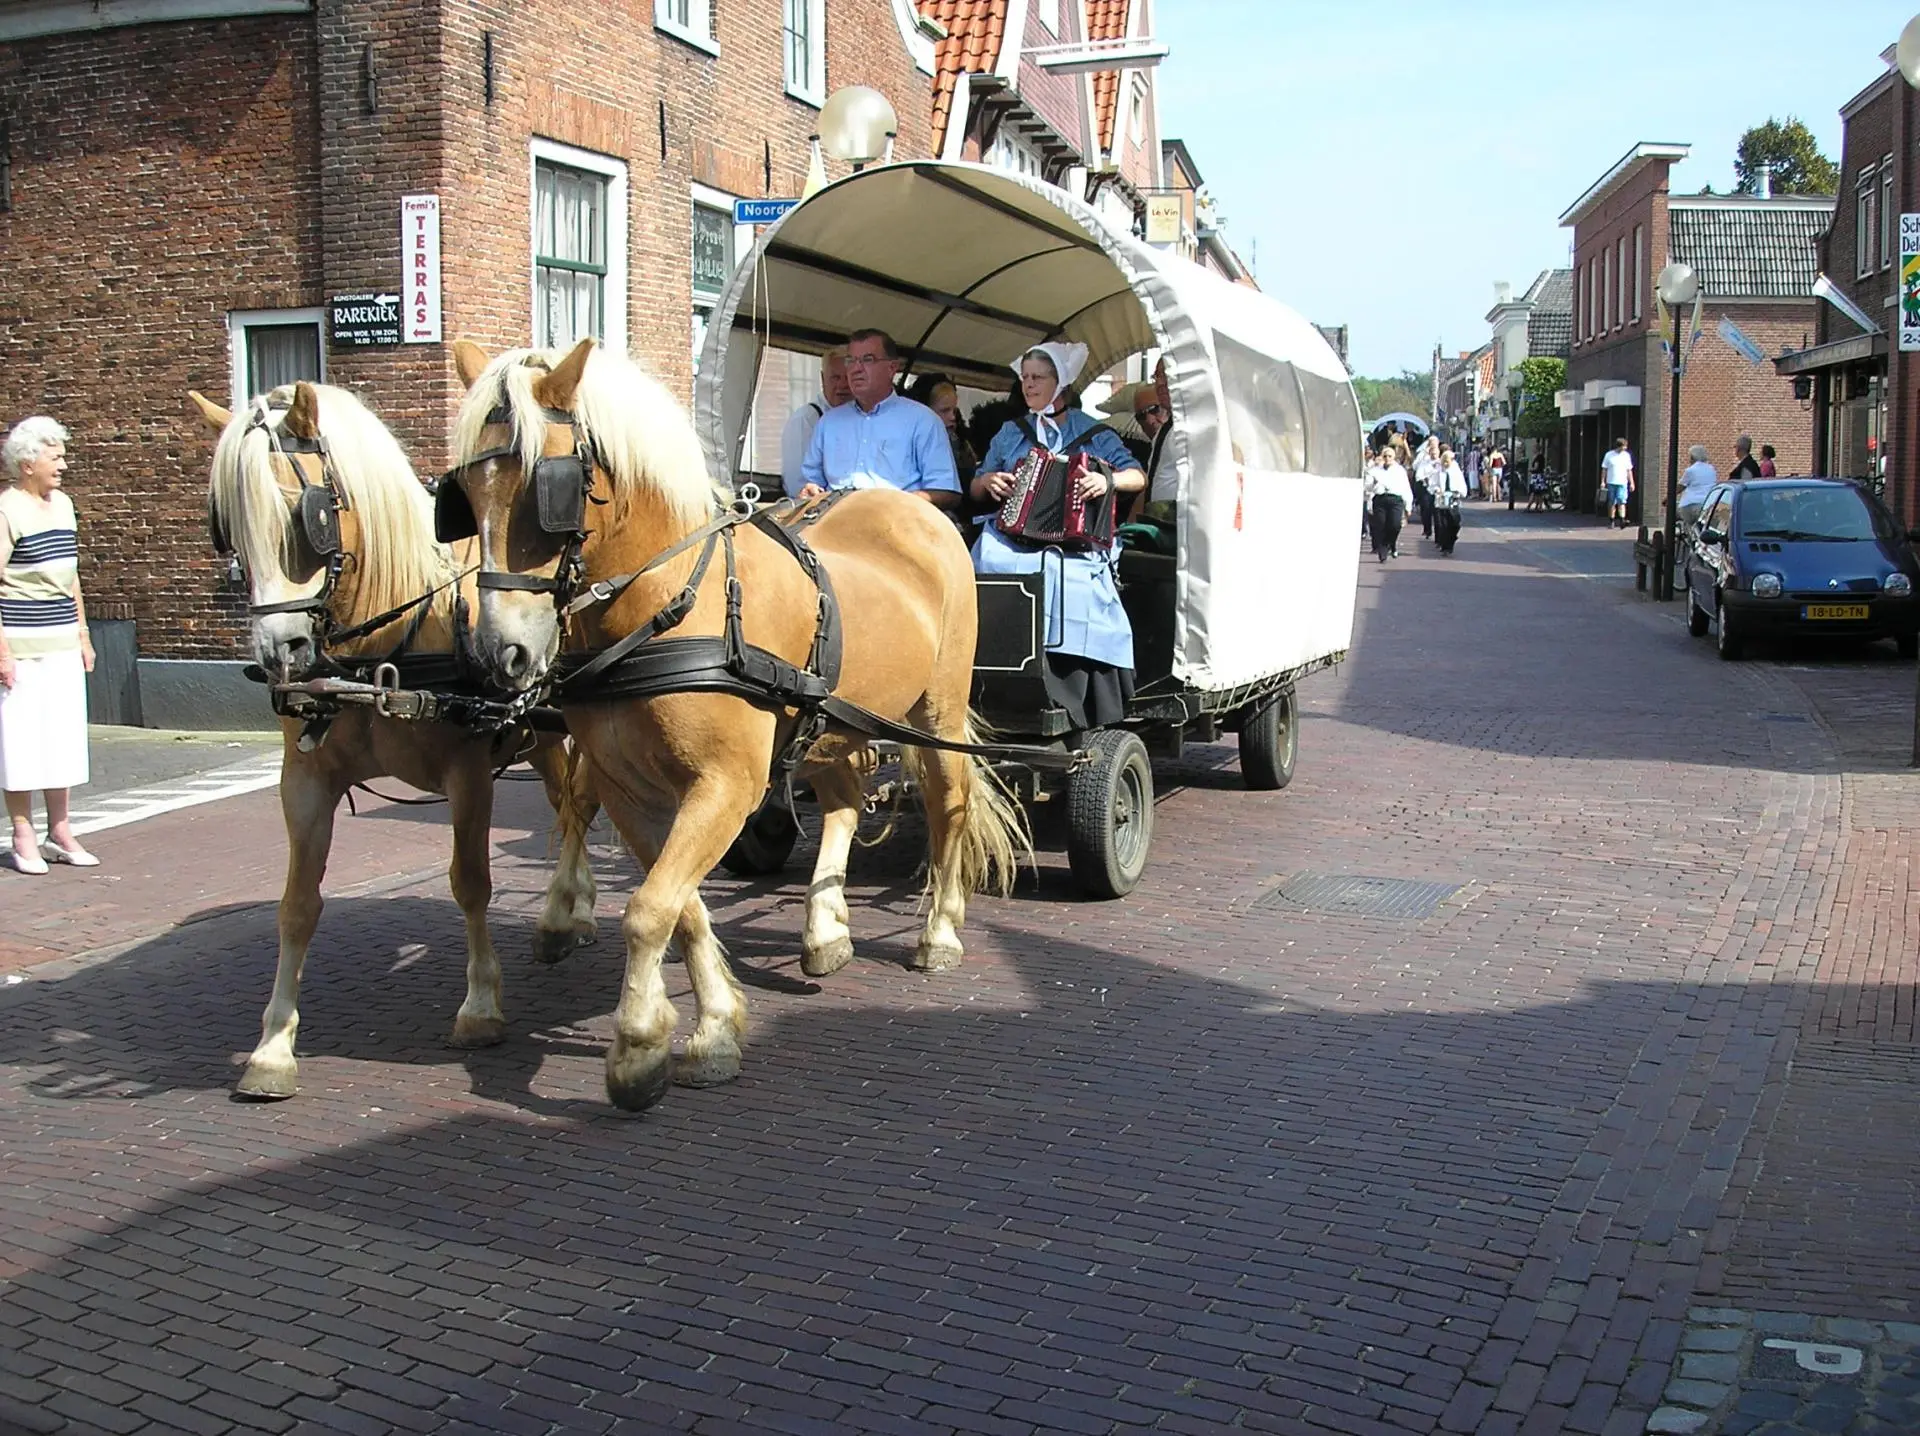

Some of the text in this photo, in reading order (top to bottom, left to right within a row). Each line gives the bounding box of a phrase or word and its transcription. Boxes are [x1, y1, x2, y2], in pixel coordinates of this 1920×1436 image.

[405, 200, 436, 210] Femi's
[1164, 208, 1178, 216] Vin
[1902, 236, 1920, 252] Del
[415, 215, 428, 324] TERRAS
[334, 305, 398, 324] RAREKIEK
